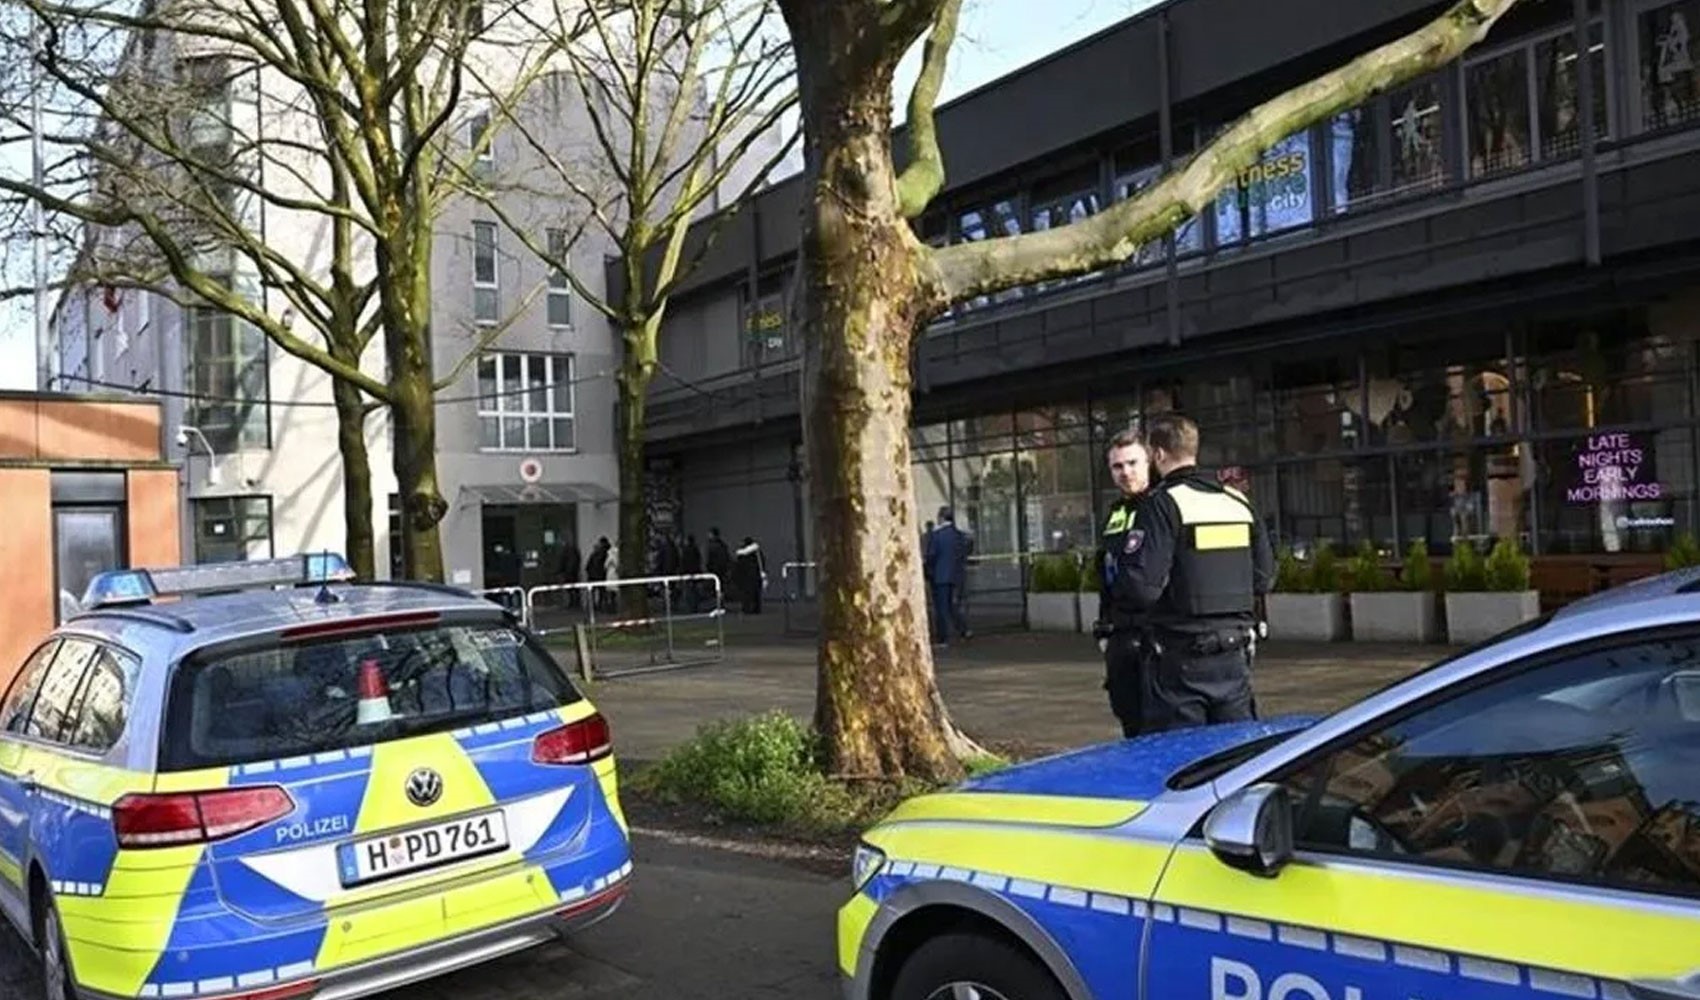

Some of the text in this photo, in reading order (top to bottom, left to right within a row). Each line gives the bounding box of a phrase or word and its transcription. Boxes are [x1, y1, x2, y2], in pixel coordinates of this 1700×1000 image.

[1588, 433, 1630, 451] LATE
[1578, 449, 1643, 469] NIGHTS
[1584, 465, 1639, 484] EARLY
[1567, 483, 1661, 501] MORNINGS
[276, 815, 348, 842] POLIZEI
[367, 841, 389, 872] H
